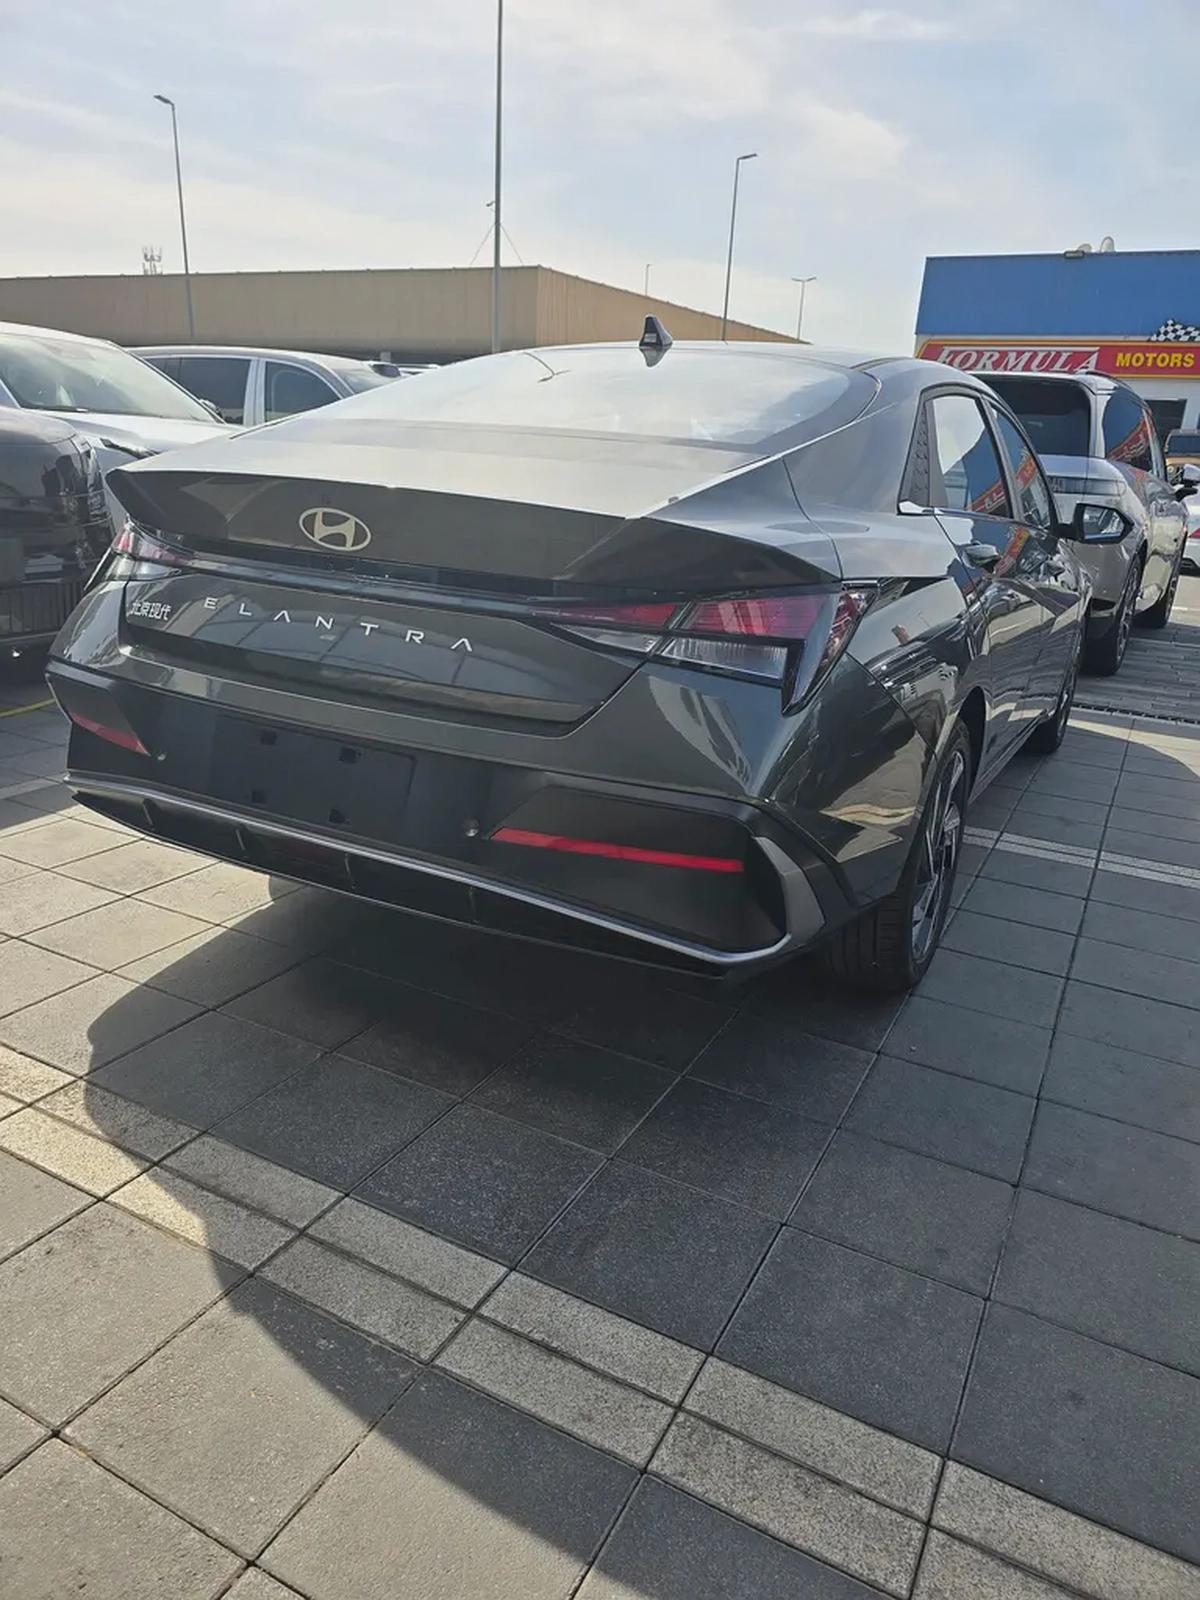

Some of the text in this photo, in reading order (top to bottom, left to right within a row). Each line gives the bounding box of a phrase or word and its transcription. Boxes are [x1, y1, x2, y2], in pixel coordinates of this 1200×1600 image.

[936, 346, 1195, 372] FORMULA MOTORS
[126, 600, 172, 621] 北京现代
[203, 596, 474, 652] ELANTRA
